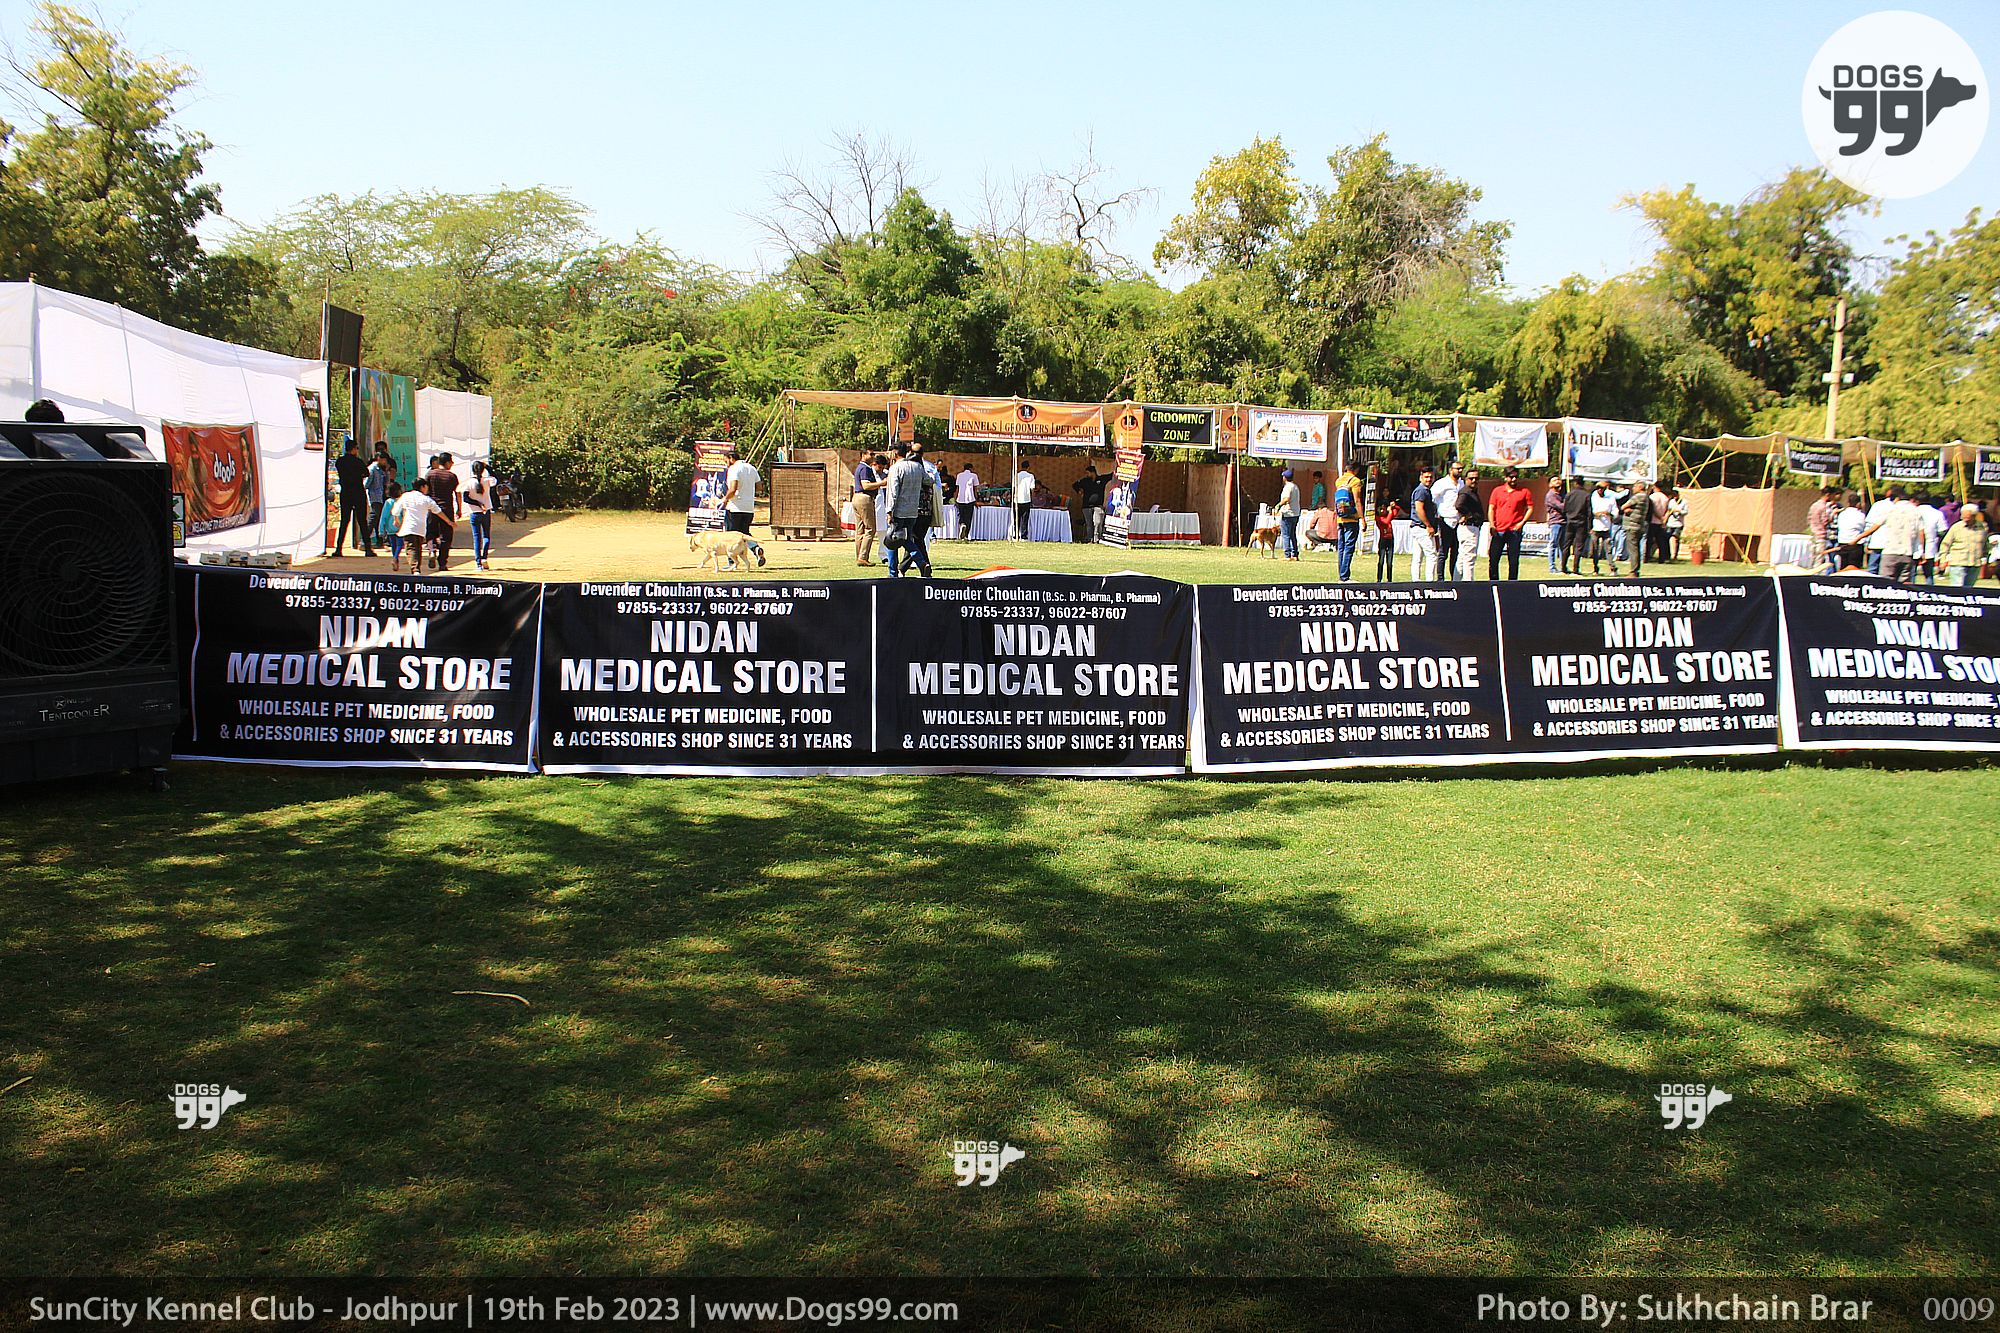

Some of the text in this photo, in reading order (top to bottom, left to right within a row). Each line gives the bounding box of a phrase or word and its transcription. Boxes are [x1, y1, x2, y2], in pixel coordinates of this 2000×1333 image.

[954, 420, 997, 431] KENNELS
[1004, 422, 1049, 433] GROOMERS
[1150, 411, 1205, 425] GROOMING
[1056, 424, 1099, 435] PET STORE
[1163, 429, 1191, 441] ZONE
[1359, 424, 1396, 440] JODHPUR
[1396, 430, 1412, 440] PET
[1569, 428, 1614, 452] Anjali
[1616, 439, 1628, 449] Pet
[213, 452, 236, 484] drools
[249, 575, 502, 597] Devender Chouhan (B.Sc. D. Pharma, B. Pharma)
[581, 583, 701, 597] Devender Chouhan
[925, 586, 1161, 605] Devender Chouhan (B.Sc. D. Pharma, B. Pharma)
[1233, 586, 1342, 601] Devender Chouhan
[1539, 583, 1641, 598] Devender Chouhan
[286, 595, 464, 611] 97855-23337, 96022-87607
[617, 602, 794, 616] 97855-23337, 96022-87607
[961, 606, 1126, 620] 97855-23337, 96022-87607
[1268, 603, 1426, 618] 97855-23337, 96022-87607
[1573, 600, 1718, 615] 97855-23337, 96022-87607
[319, 616, 427, 649] NIDAN
[651, 621, 758, 653] NIDAN
[994, 624, 1096, 657] NIDAN
[1300, 621, 1399, 653] NIDAN
[1604, 617, 1694, 648] NIDAN
[1872, 618, 1959, 650] NIDAN
[227, 652, 513, 692] MEDICAL STORE
[1532, 650, 1773, 687] MEDICAL STORE
[1808, 648, 1942, 680] MEDICAL
[561, 659, 846, 694] MEDICAL STORE
[909, 663, 1179, 697] MEDICAL STORE
[1224, 657, 1480, 695] MEDICAL STORE
[1547, 692, 1764, 714] WHOLESALE PET MEDICINE, FOOD
[1825, 689, 1930, 705] WHOLESALE PET
[39, 704, 111, 722] TENTCOOLER
[239, 700, 494, 723] WHOLESALE PET MEDICINE, FOOD
[574, 706, 832, 726] WHOLESALE PET MEDICINE, FOOD
[923, 710, 1166, 728] WHOLESALE PET MEDICINE, FOOD
[1238, 701, 1470, 723] WHOLESALE PET MEDICINE, FOOD
[1811, 712, 1952, 728] & ACCESSORIES SHOP
[221, 724, 513, 746] & ACCESSORIES SHOP SINCE 31 YEARS
[1220, 723, 1489, 747] & ACCESSORIES SHOP SINCE 31 YEARS
[1533, 722, 1543, 737] &
[1547, 720, 1637, 736] ACCESSORIES
[1641, 720, 1676, 734] SHOP
[1680, 716, 1720, 733] SINCE
[1723, 715, 1740, 731] 31
[553, 731, 852, 749] & ACCESSORIES SHOP SINCE 31 YEARS
[903, 734, 1184, 750] & ACCESSORIES SHOP SINCE 31 YEARS
